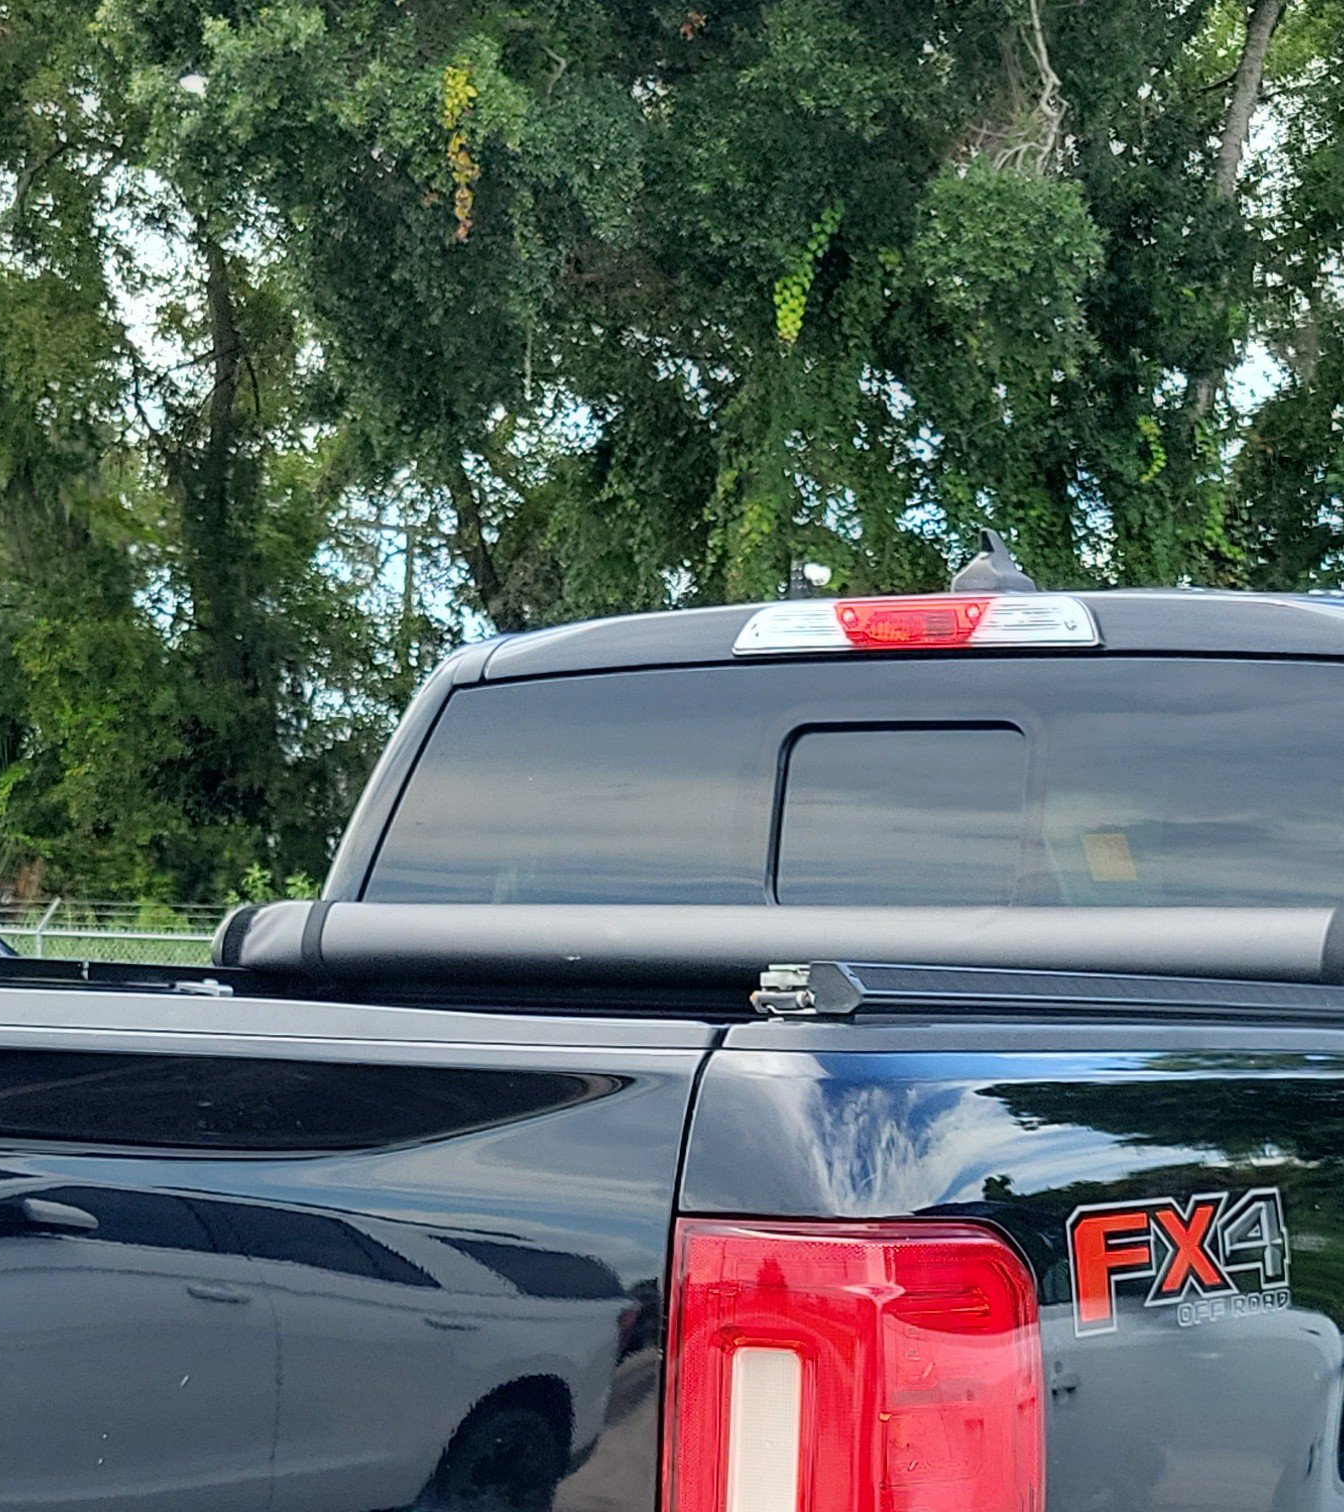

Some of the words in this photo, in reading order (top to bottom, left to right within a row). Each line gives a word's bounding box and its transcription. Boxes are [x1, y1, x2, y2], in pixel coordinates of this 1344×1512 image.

[1067, 1187, 1291, 1337] FX4
[1177, 1300, 1226, 1327] OFF
[1231, 1289, 1291, 1317] ROAD
